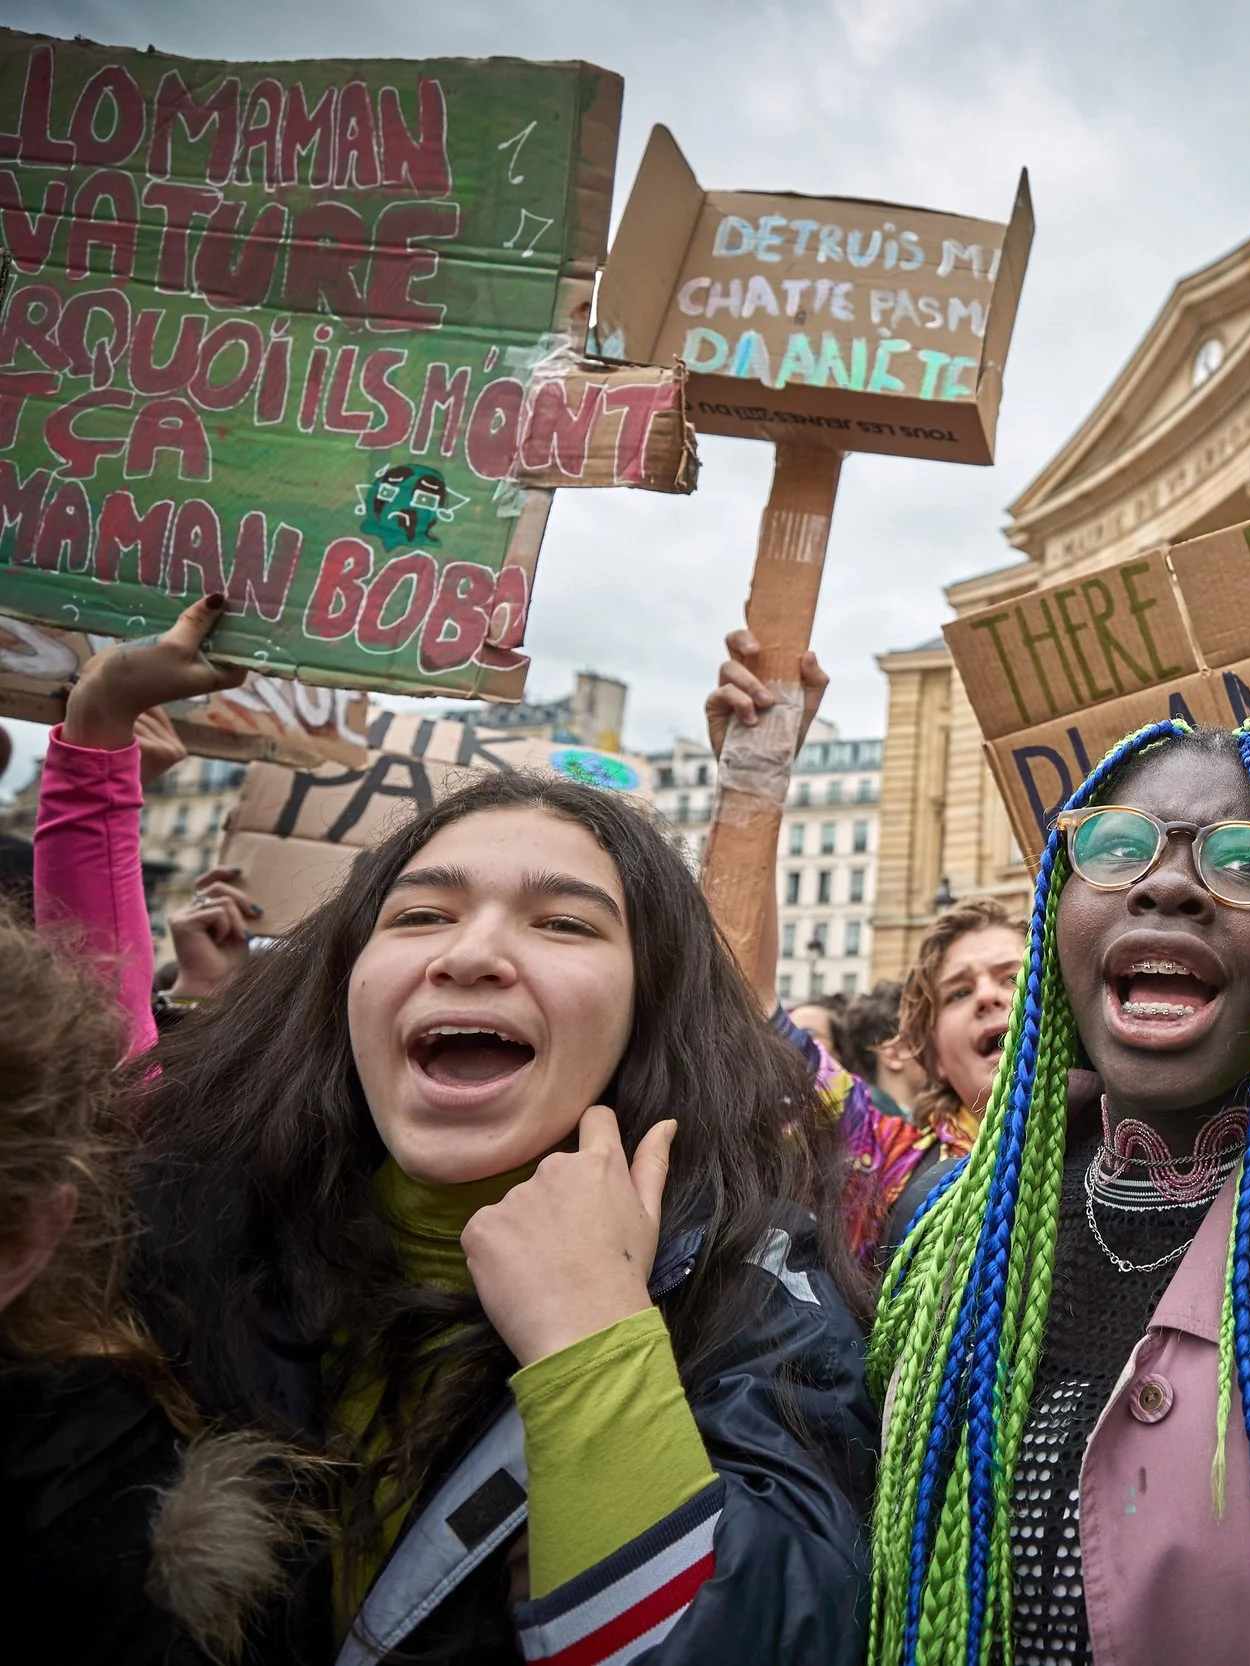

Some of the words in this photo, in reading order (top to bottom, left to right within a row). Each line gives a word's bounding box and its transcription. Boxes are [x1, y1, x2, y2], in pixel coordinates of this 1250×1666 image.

[147, 76, 453, 199] MAMAN
[677, 275, 856, 321] CHATTE
[43, 387, 213, 483] ÇA
[856, 419, 895, 436] LES
[901, 424, 959, 444] TOUS
[969, 562, 1183, 725] THERE
